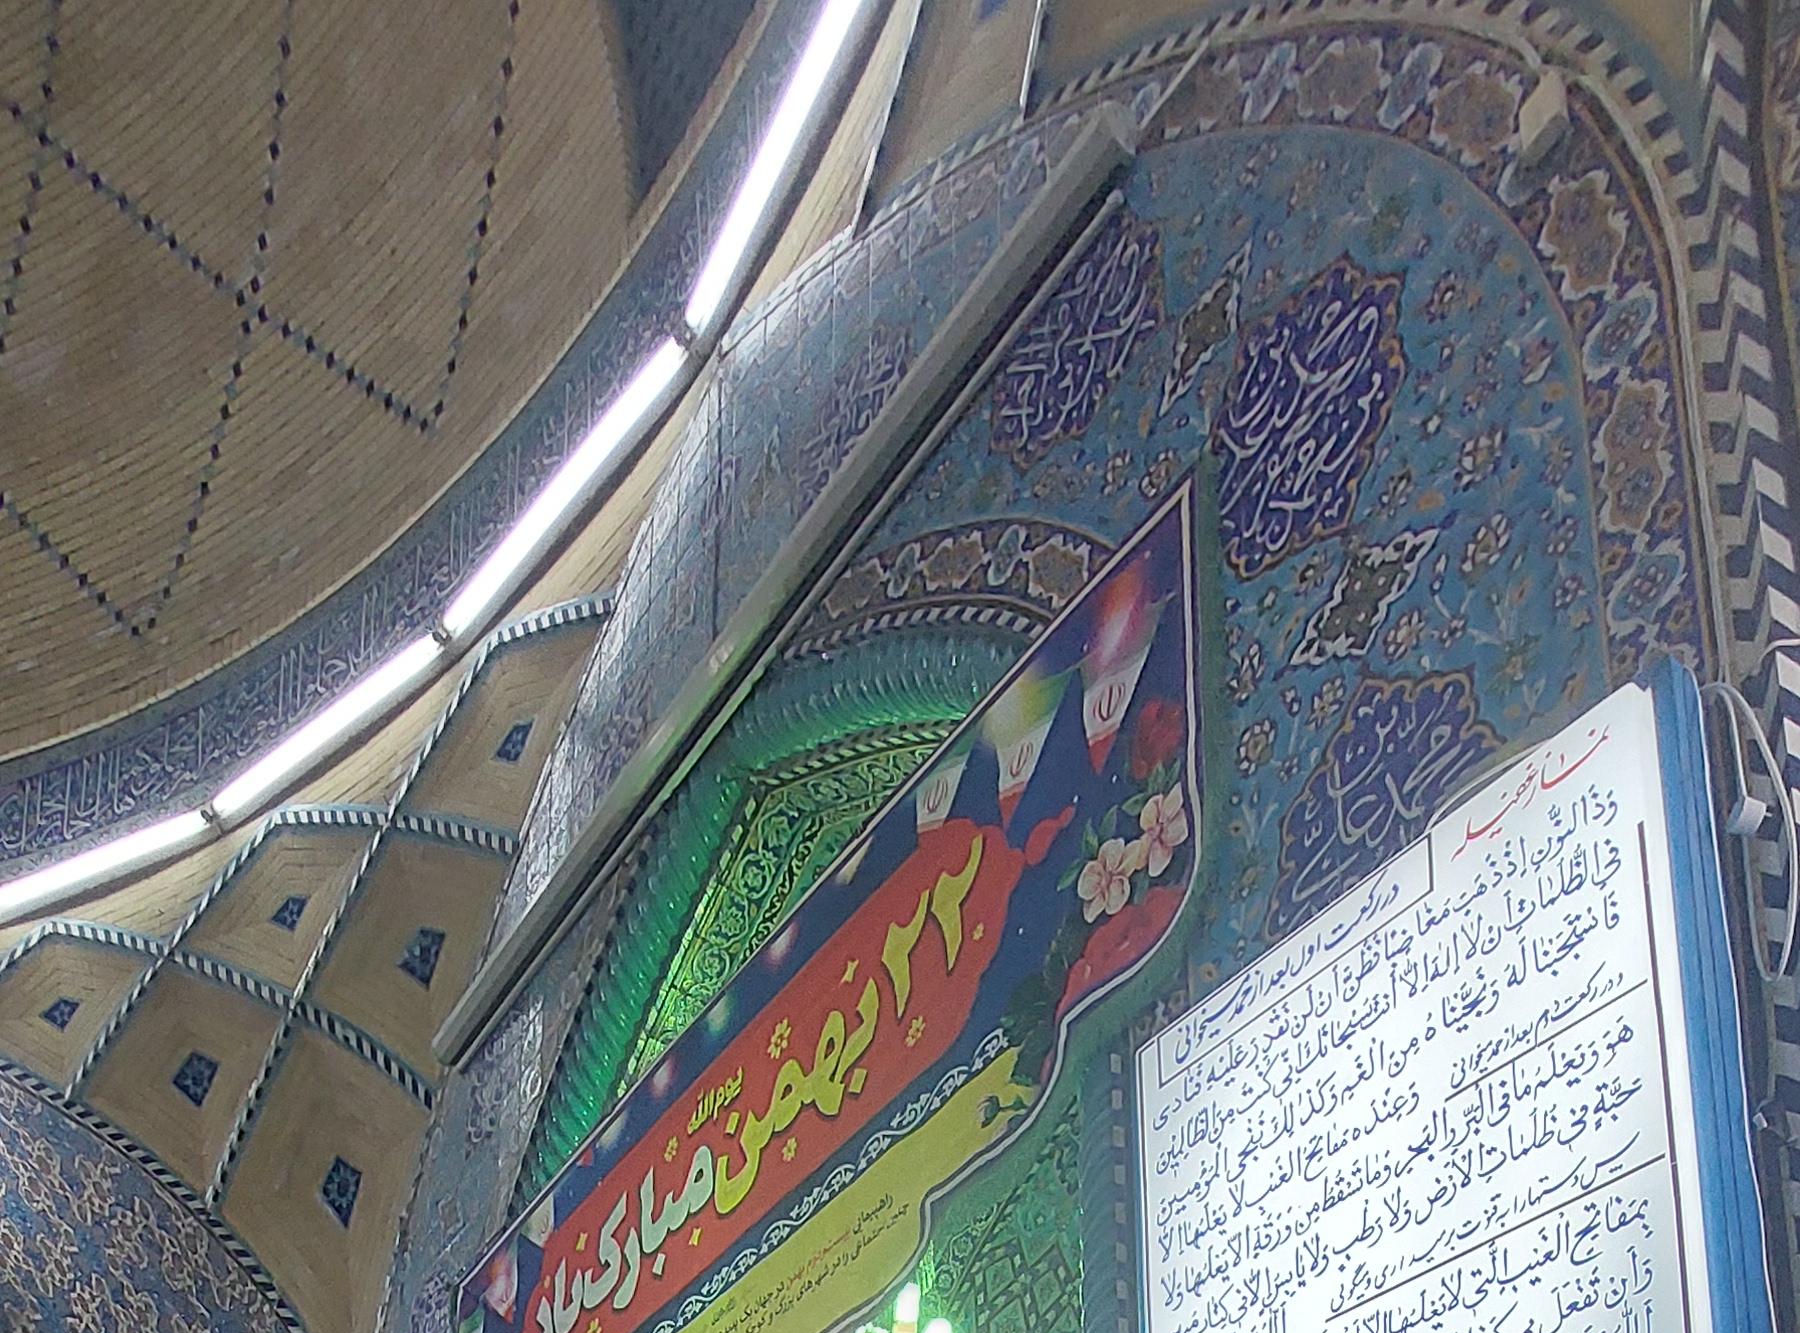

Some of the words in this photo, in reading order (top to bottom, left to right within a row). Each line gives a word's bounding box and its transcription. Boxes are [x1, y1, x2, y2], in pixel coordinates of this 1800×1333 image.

[1517, 725, 1608, 809] نماز
[881, 834, 984, 1018] ۲۲
[1320, 865, 1390, 951] رکعت
[1379, 883, 1399, 911] در
[1244, 970, 1264, 1006] از
[1263, 956, 1290, 996] بعد
[1289, 932, 1320, 977] اول
[714, 976, 880, 1215] بهمن
[583, 1146, 714, 1309] مبارک
